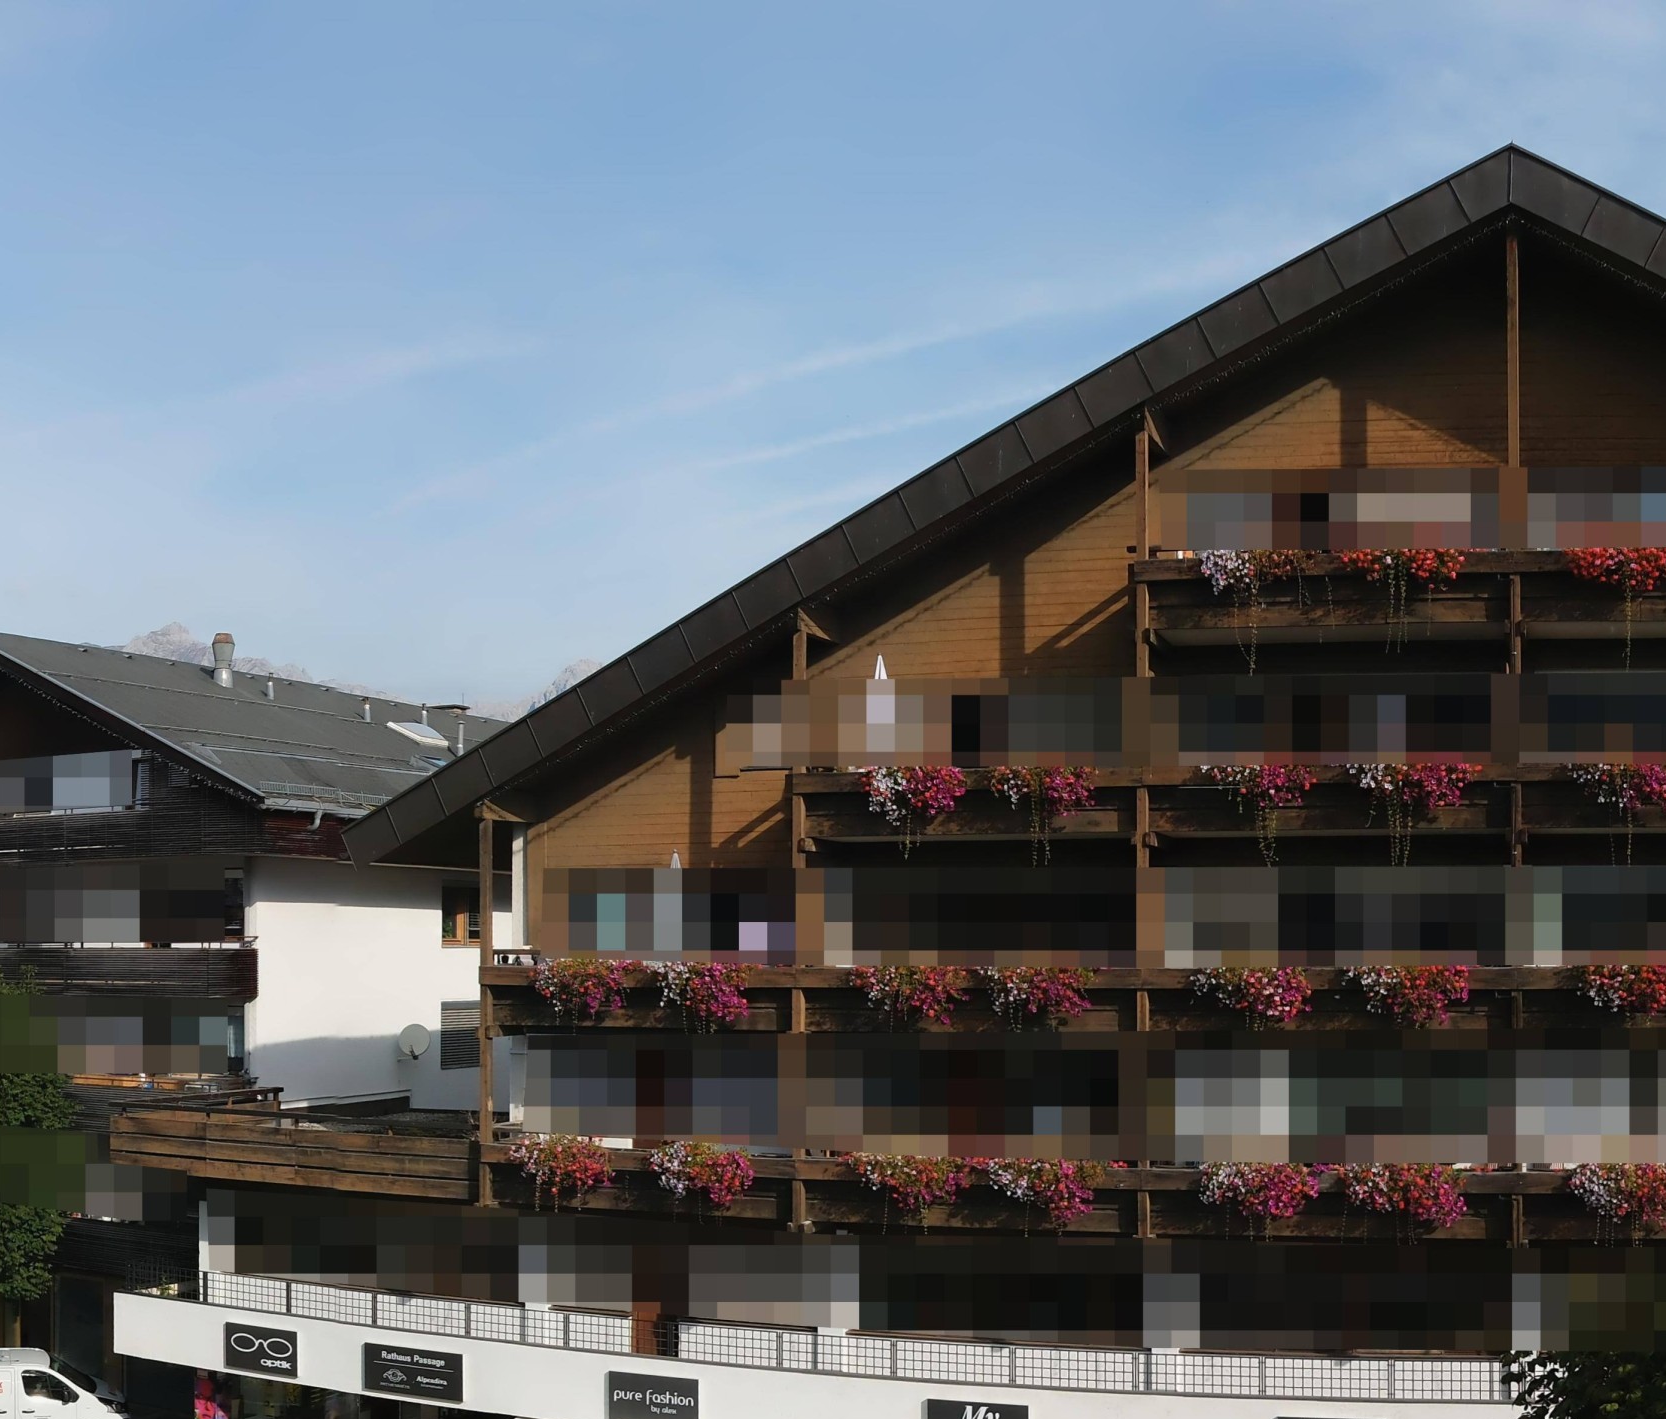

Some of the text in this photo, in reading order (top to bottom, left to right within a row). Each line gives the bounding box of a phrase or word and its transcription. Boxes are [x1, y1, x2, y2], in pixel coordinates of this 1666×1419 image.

[261, 1358, 292, 1370] optik
[381, 1350, 446, 1368] Rathaus Passage
[614, 1389, 694, 1407] pure fashion
[651, 1404, 677, 1415] by alex
